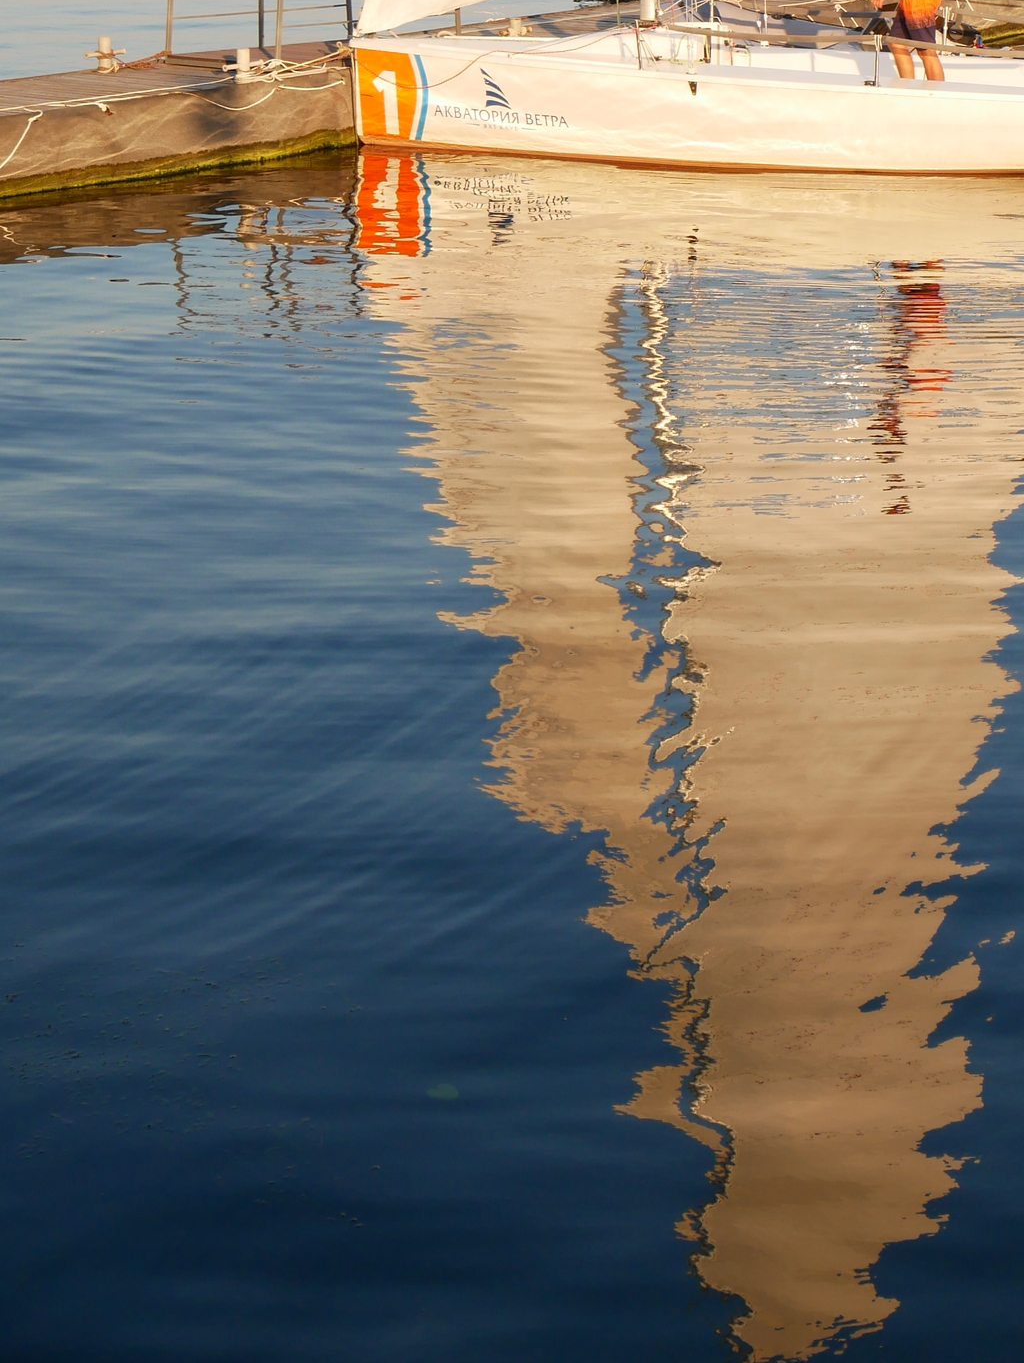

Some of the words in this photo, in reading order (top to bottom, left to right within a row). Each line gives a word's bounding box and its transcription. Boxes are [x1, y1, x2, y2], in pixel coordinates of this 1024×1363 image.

[371, 70, 401, 136] 1
[434, 104, 519, 124] АКВАТОРИЯ
[525, 112, 569, 129] ВЕТРА
